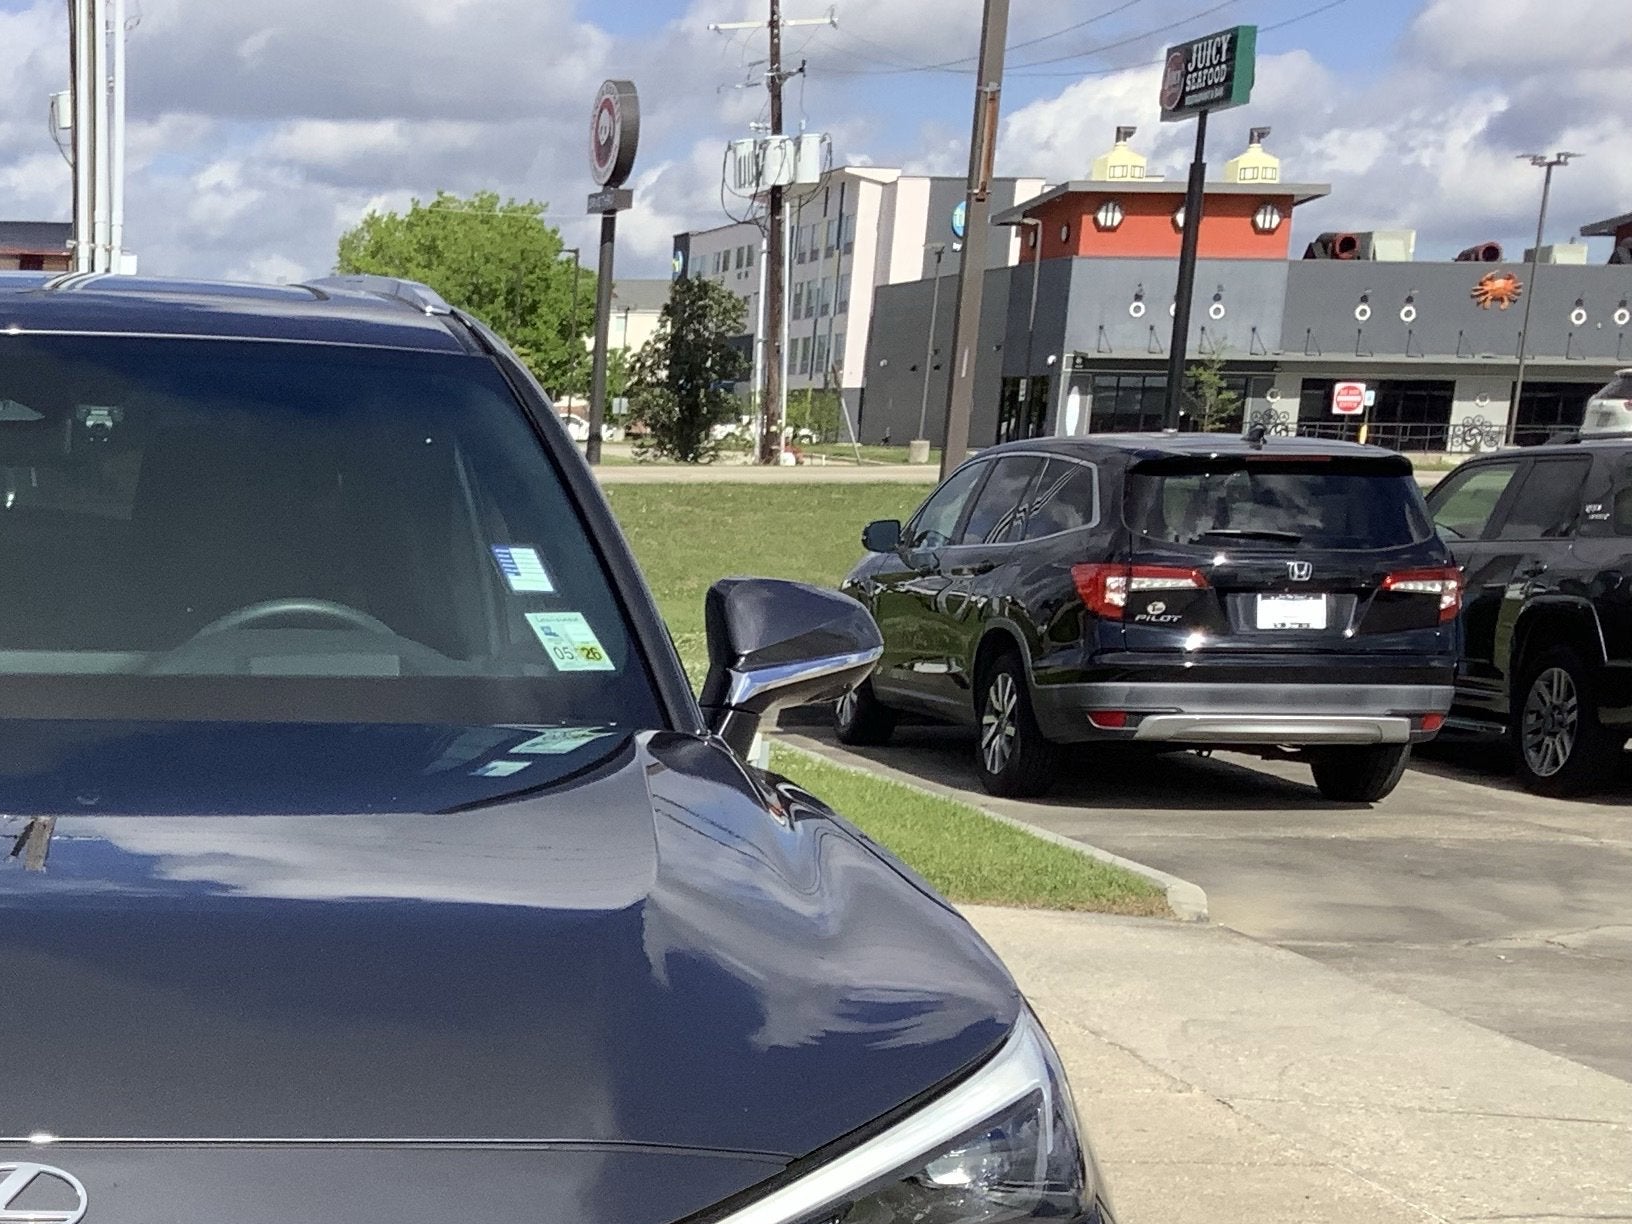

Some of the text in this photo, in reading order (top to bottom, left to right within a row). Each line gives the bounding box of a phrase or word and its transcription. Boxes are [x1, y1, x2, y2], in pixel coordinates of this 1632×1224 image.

[1188, 33, 1232, 72] JUICY
[1185, 64, 1227, 92] SEAFOOD
[1135, 614, 1183, 622] PILOT
[553, 646, 603, 661] 05 26
